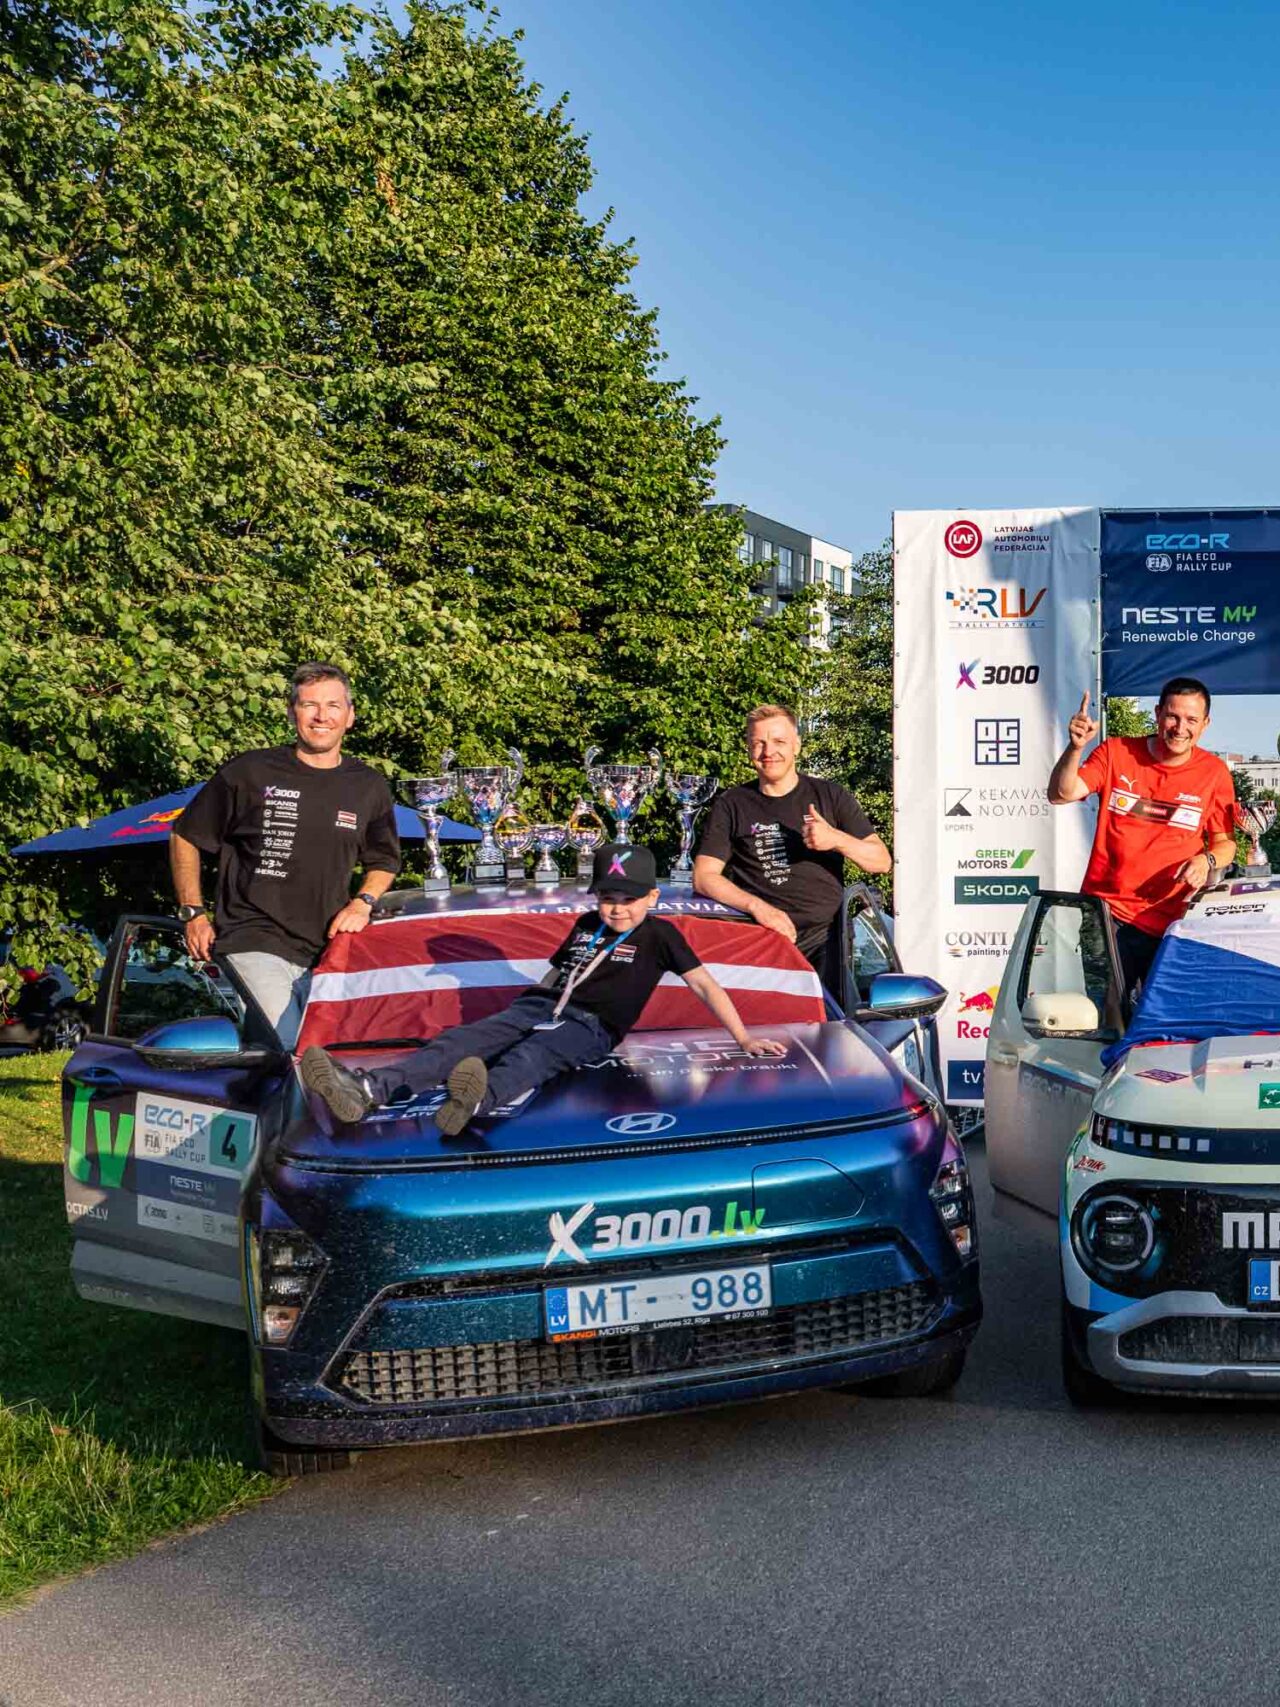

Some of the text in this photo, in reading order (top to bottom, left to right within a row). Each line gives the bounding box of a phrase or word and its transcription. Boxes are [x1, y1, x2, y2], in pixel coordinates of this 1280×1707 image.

[1177, 553, 1217, 562] FIA ECO
[1176, 562, 1232, 572] RALLY CUP
[1223, 605, 1257, 624] MY
[1122, 630, 1256, 645] Renewable Charge
[979, 804, 1049, 816] NOVADS
[975, 849, 1016, 859] GREEN
[958, 860, 1009, 869] MOTORS
[967, 949, 1001, 957] painting
[221, 1123, 237, 1163] 4
[1254, 1286, 1269, 1296] CZ
[551, 1315, 567, 1327] LV
[552, 1325, 640, 1343] SKANDI MOTORS
